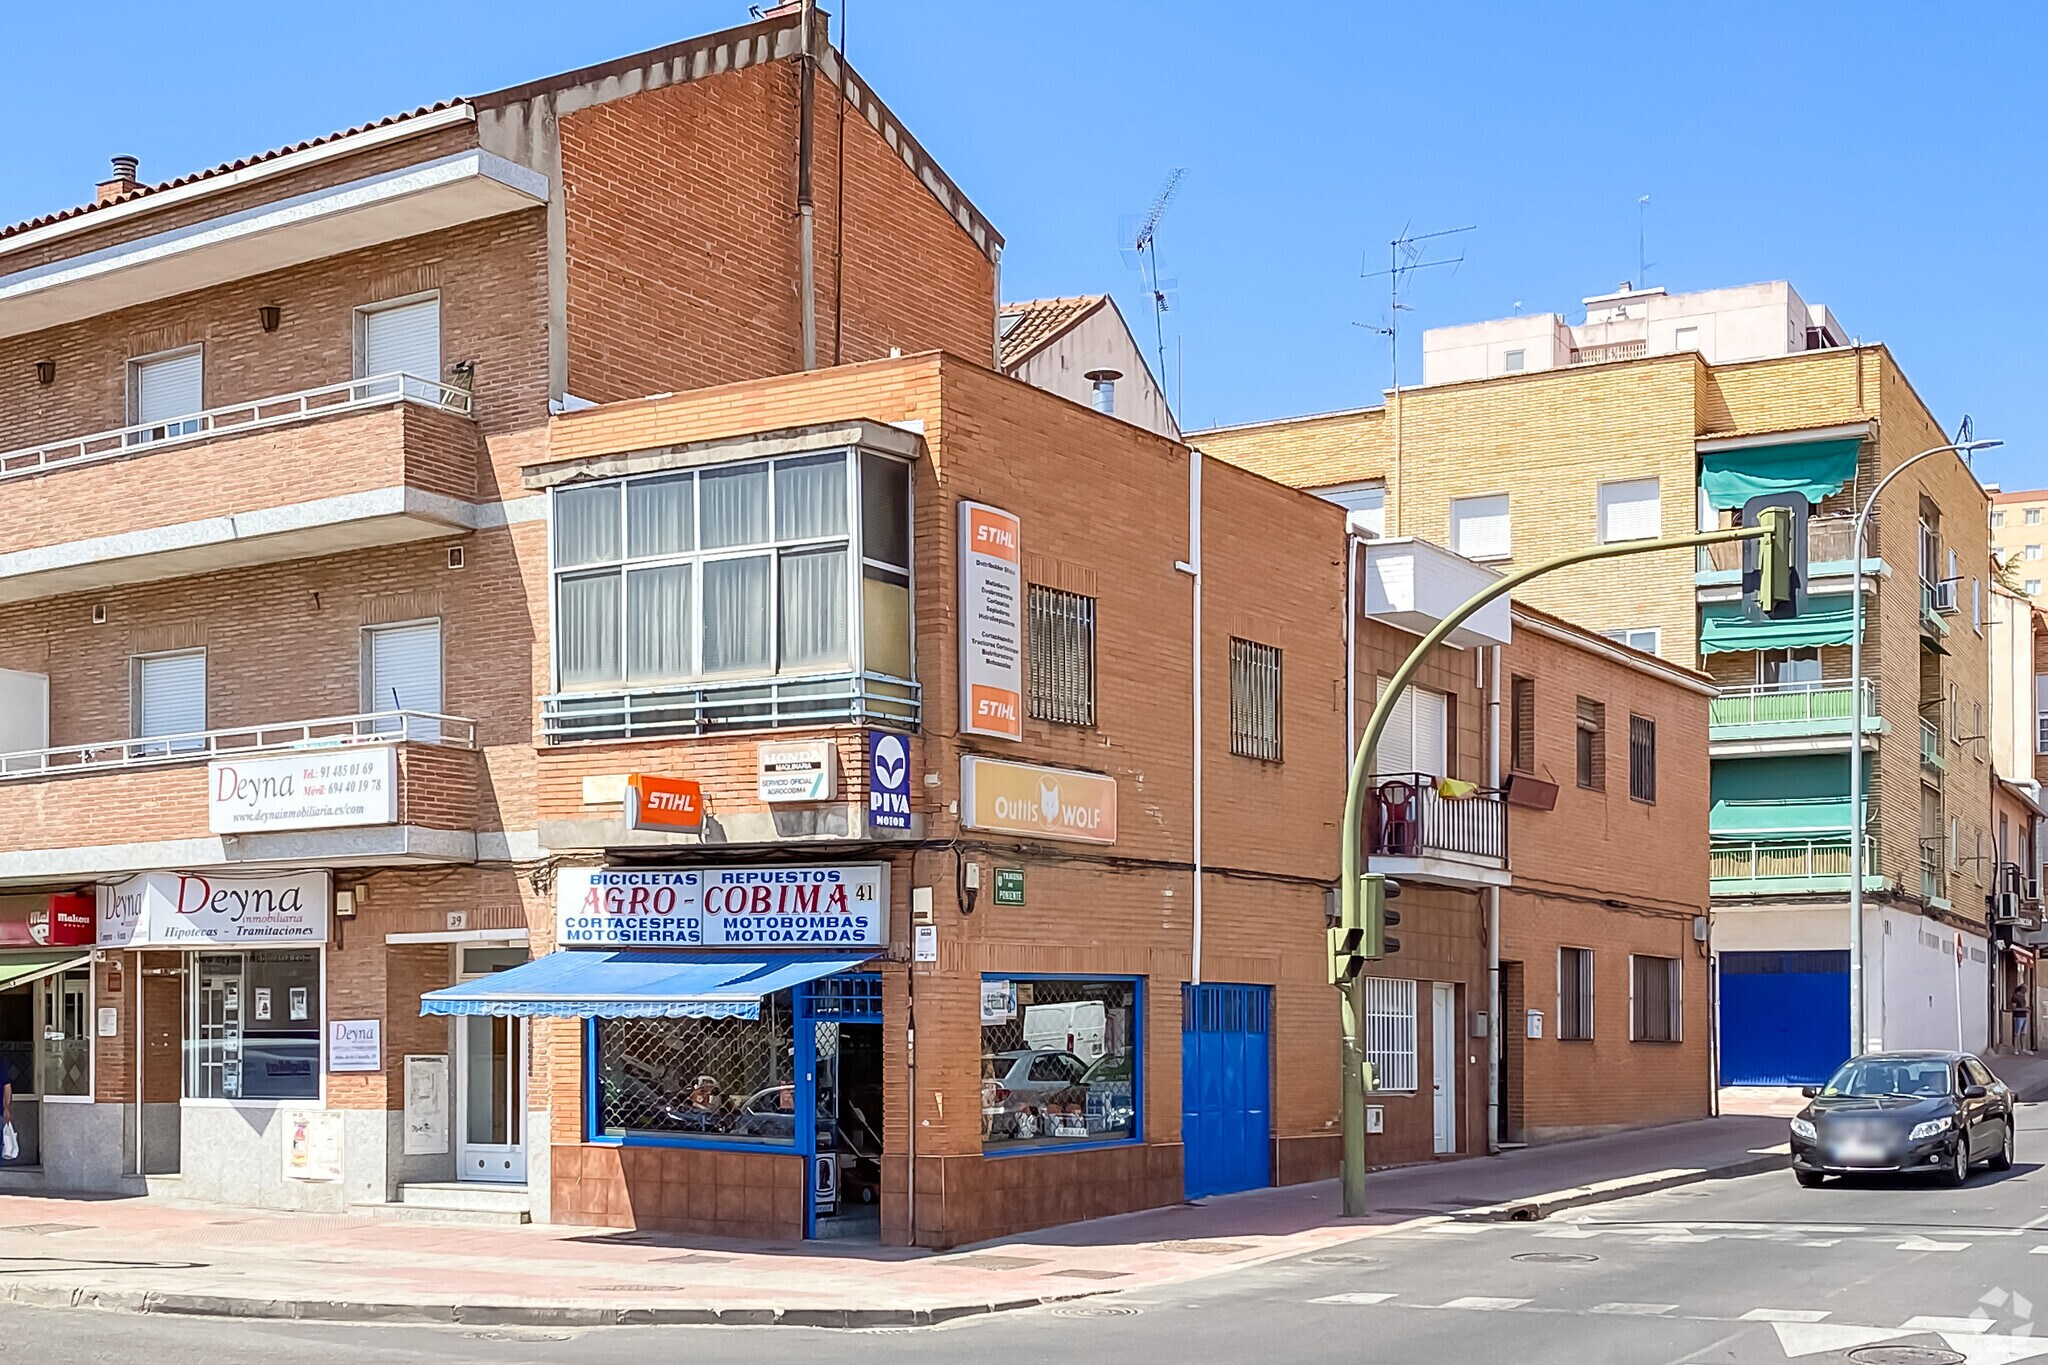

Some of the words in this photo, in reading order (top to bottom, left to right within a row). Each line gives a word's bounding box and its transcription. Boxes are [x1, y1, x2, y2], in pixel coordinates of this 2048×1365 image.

[977, 525, 1014, 549] STIHL
[978, 700, 1015, 720] STIHL
[764, 750, 822, 763] HONDA
[321, 766, 330, 776] 91
[333, 765, 346, 776] 485
[350, 764, 359, 776] 01
[362, 763, 373, 774] 69
[776, 763, 812, 771] MAQUINARIA
[217, 768, 294, 806] Deyna
[328, 783, 341, 794] 694
[345, 782, 355, 793] 40
[358, 780, 368, 792] 19
[372, 779, 381, 790] 78
[762, 779, 788, 787] SERVICIO
[648, 792, 694, 812] STIHL
[871, 792, 910, 813] PIVA
[995, 796, 1039, 822] Outils
[1062, 804, 1100, 829] WOLF
[877, 815, 904, 826] MOTOR
[590, 874, 698, 885] BICICLETAS
[721, 871, 840, 883] REPUESTOS
[176, 876, 303, 922] Deyna
[580, 886, 676, 916] AGRO
[704, 884, 852, 916] COBIMA
[856, 885, 873, 901] 41
[106, 885, 141, 926] Deyna
[58, 913, 90, 923] Mahou
[242, 913, 303, 924] inmobiliaria
[451, 916, 461, 926] 39
[565, 917, 700, 929] CORTACESPED
[723, 916, 869, 929] MOTOBOMBAS
[165, 927, 218, 939] Hipotecas
[237, 926, 313, 936] Tramitaciones
[567, 930, 700, 942] MOTOSIERRAS
[725, 930, 866, 941] MOTOAZADAS
[336, 1024, 373, 1043] Deyna
